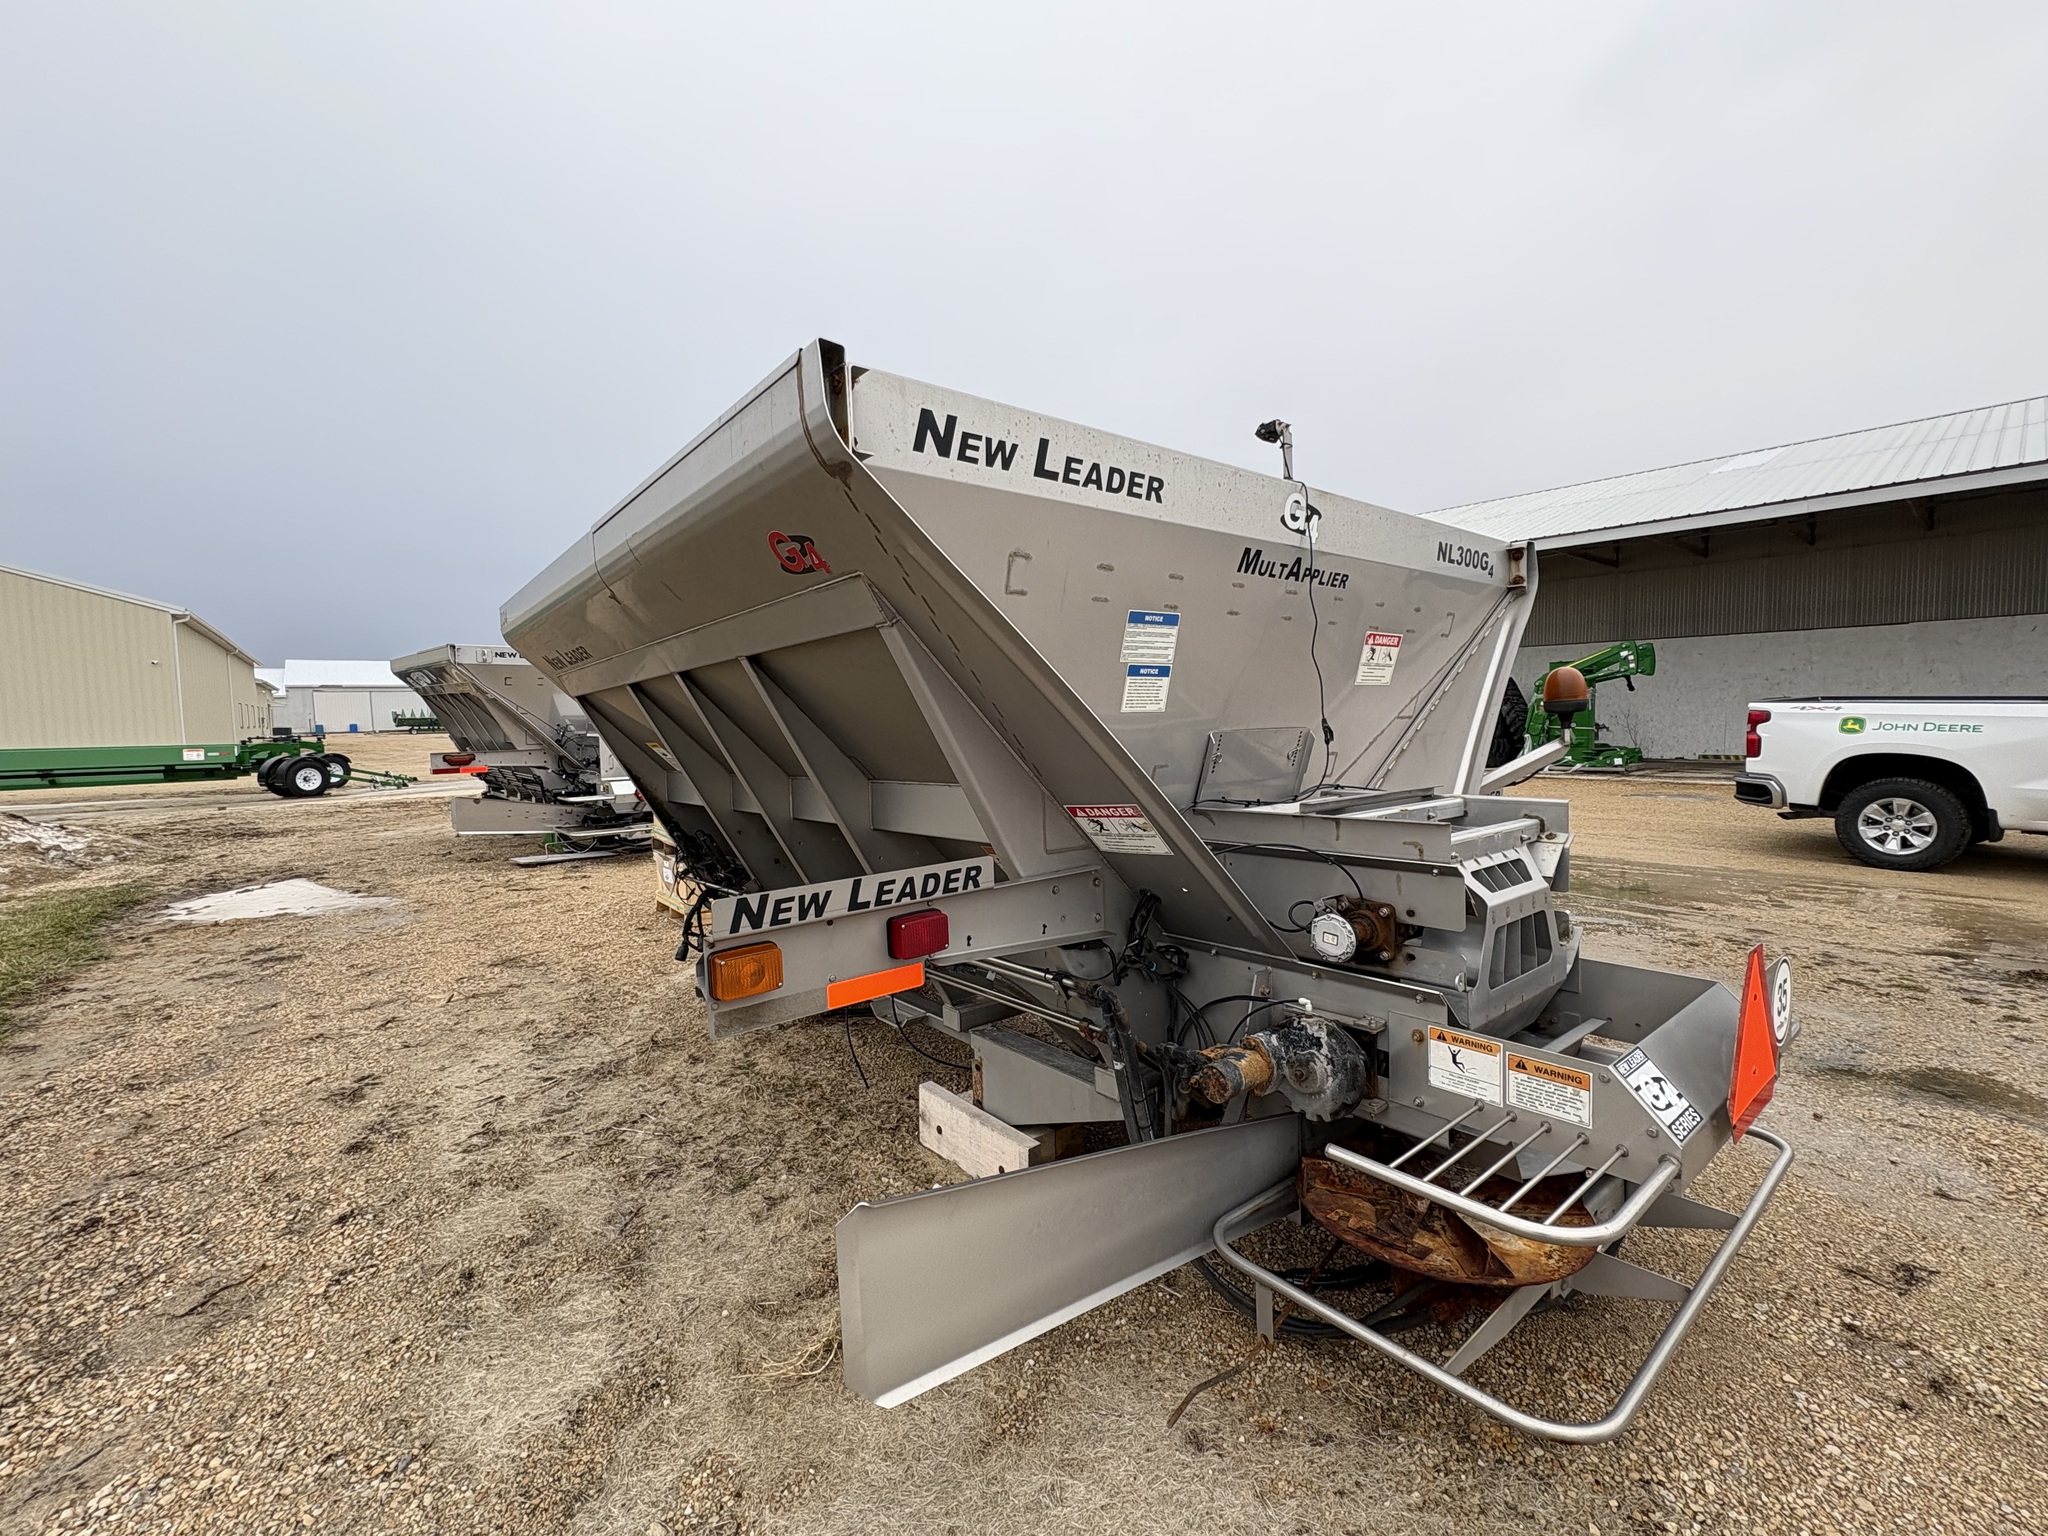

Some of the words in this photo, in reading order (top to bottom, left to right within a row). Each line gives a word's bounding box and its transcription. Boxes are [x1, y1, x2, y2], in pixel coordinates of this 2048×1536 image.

[912, 407, 1019, 471] NEW
[1033, 437, 1166, 504] LEADER
[1144, 615, 1164, 623] NOTICE
[1374, 635, 1399, 646] DANGER
[494, 651, 518, 659] NEW
[541, 654, 568, 671] NEW
[555, 645, 594, 666] LEADER
[1872, 721, 1919, 732] JOHN
[1922, 722, 1984, 733] DEERE
[1085, 807, 1136, 817] DANGER
[729, 890, 833, 935] NEW
[847, 865, 983, 912] LEADER
[1777, 977, 1788, 1017] 35
[1450, 1035, 1493, 1053] WARNING
[1533, 1065, 1583, 1085] WARNING
[1671, 1107, 1701, 1140] SERIES
